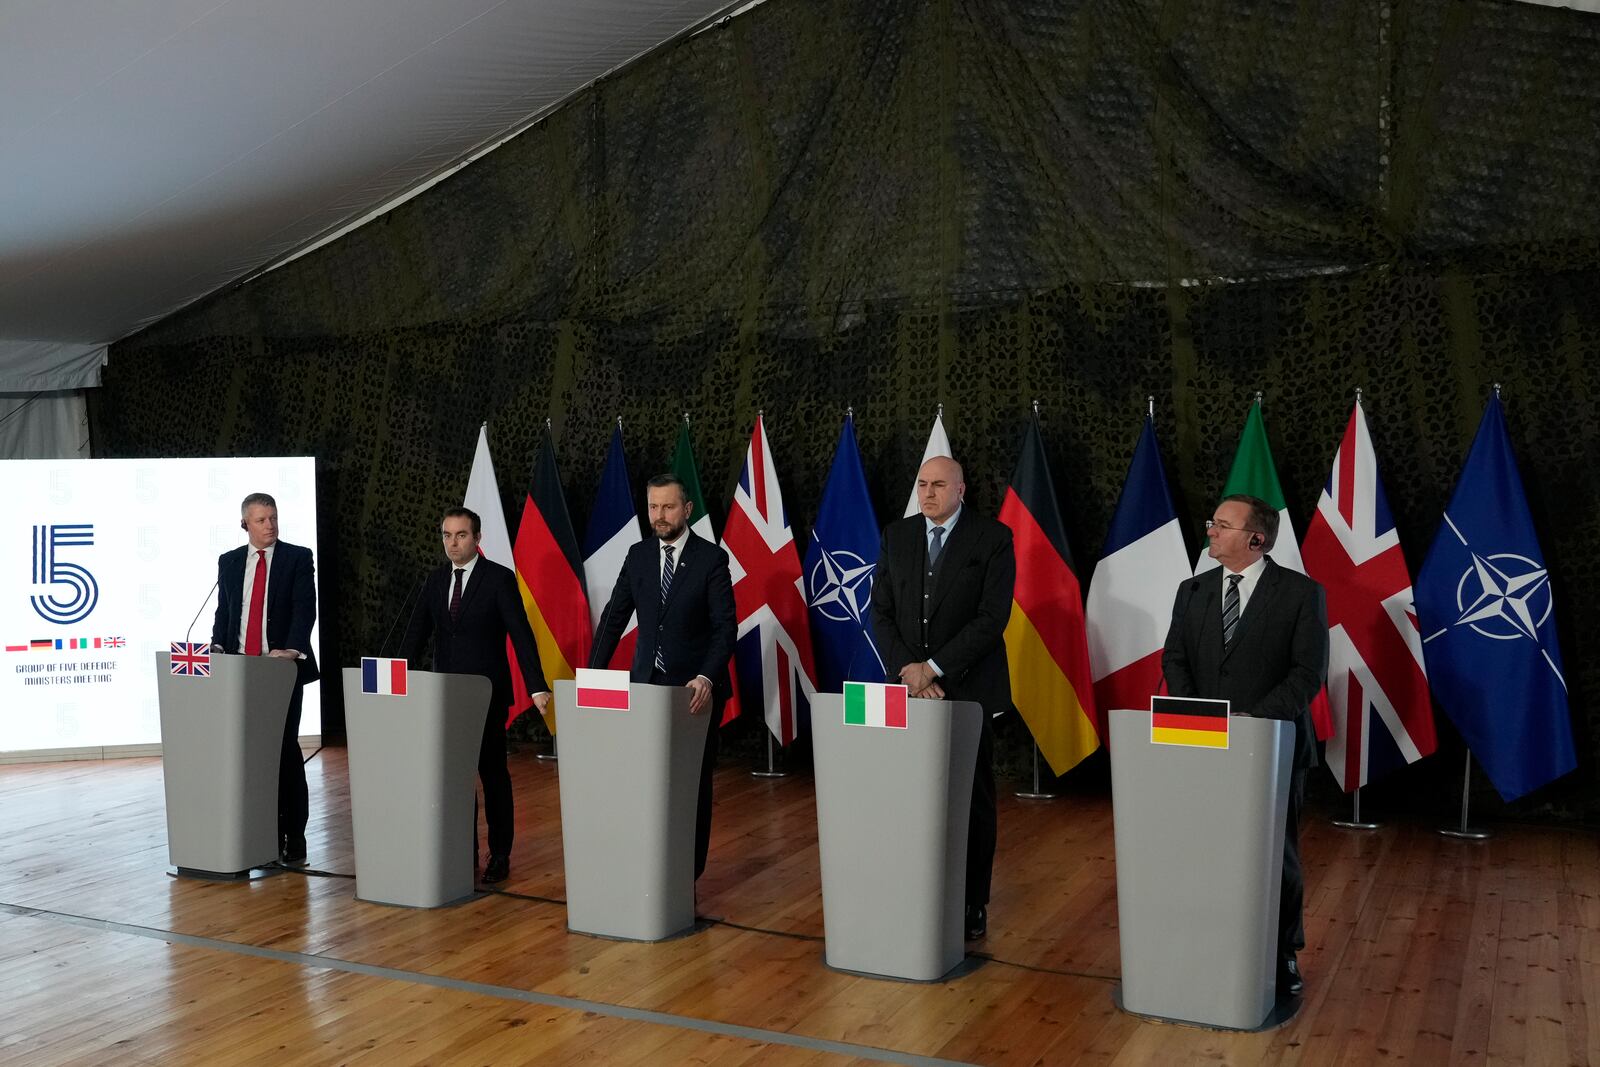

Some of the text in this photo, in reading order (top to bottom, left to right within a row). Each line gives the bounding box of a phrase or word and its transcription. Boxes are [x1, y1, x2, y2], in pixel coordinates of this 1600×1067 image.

[30, 524, 99, 625] 5
[16, 661, 117, 674] GROUP OF FIVE DEFENCE
[24, 674, 112, 686] MINISTERS MEETING
